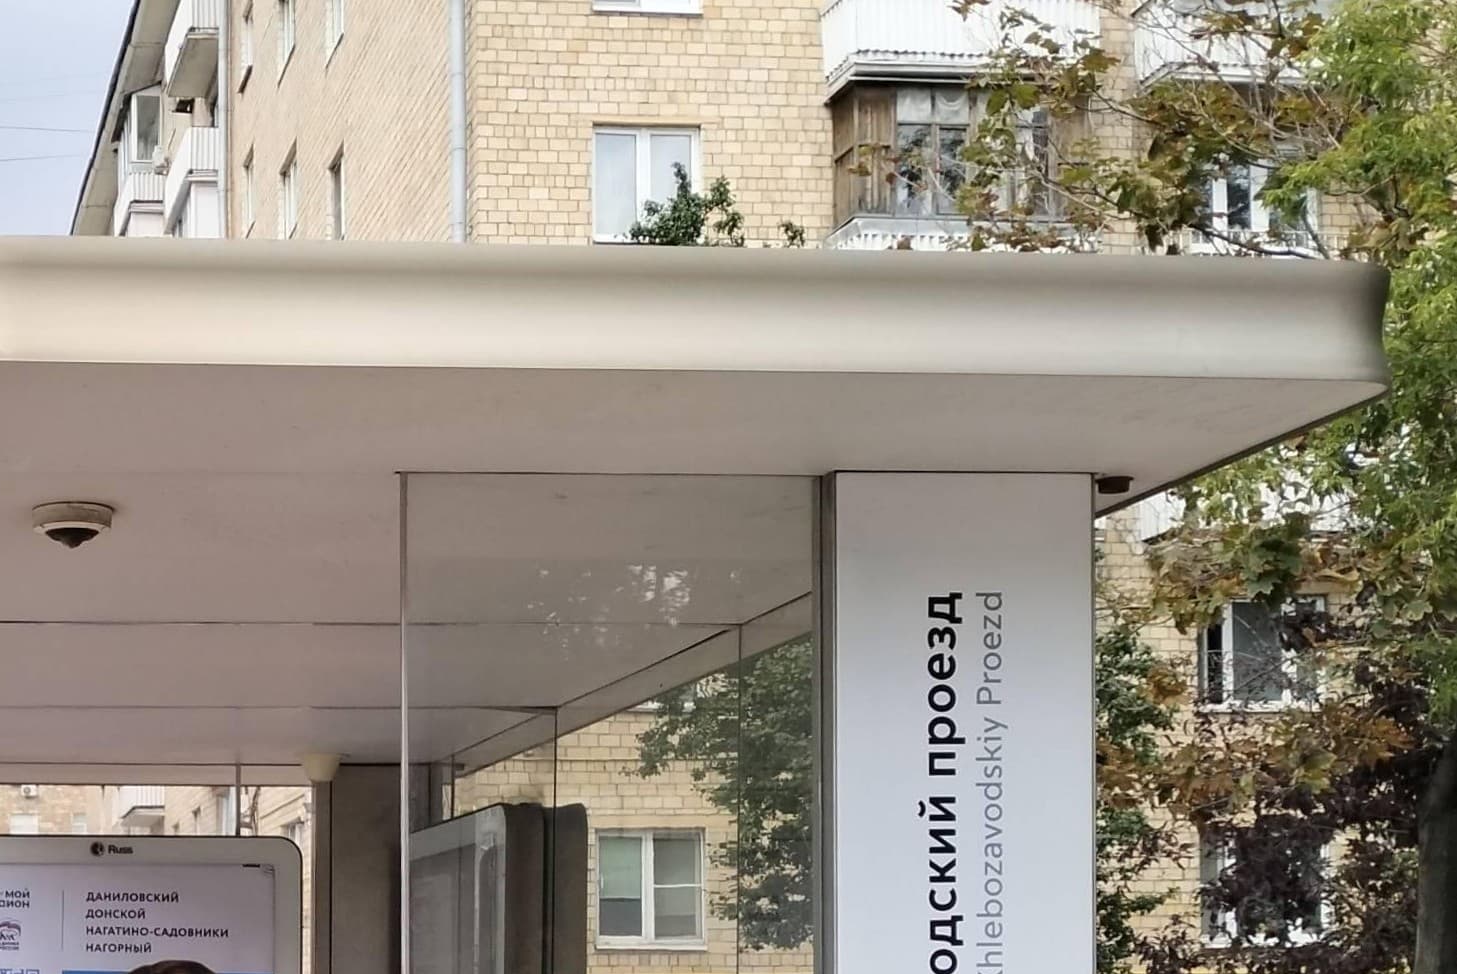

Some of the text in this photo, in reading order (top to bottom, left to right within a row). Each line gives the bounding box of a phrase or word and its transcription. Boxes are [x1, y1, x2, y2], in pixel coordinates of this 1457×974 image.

[975, 590, 1004, 706] Proezd
[927, 592, 964, 778] проезд
[108, 845, 134, 854] Russ
[86, 891, 180, 904] ДАНИЛОВСКИЙ
[86, 907, 146, 921] ДОНСКОЙ
[86, 925, 229, 939] НАГАТИНО-САДОВНИКИ
[86, 942, 152, 954] НАГОРНЫЙ
